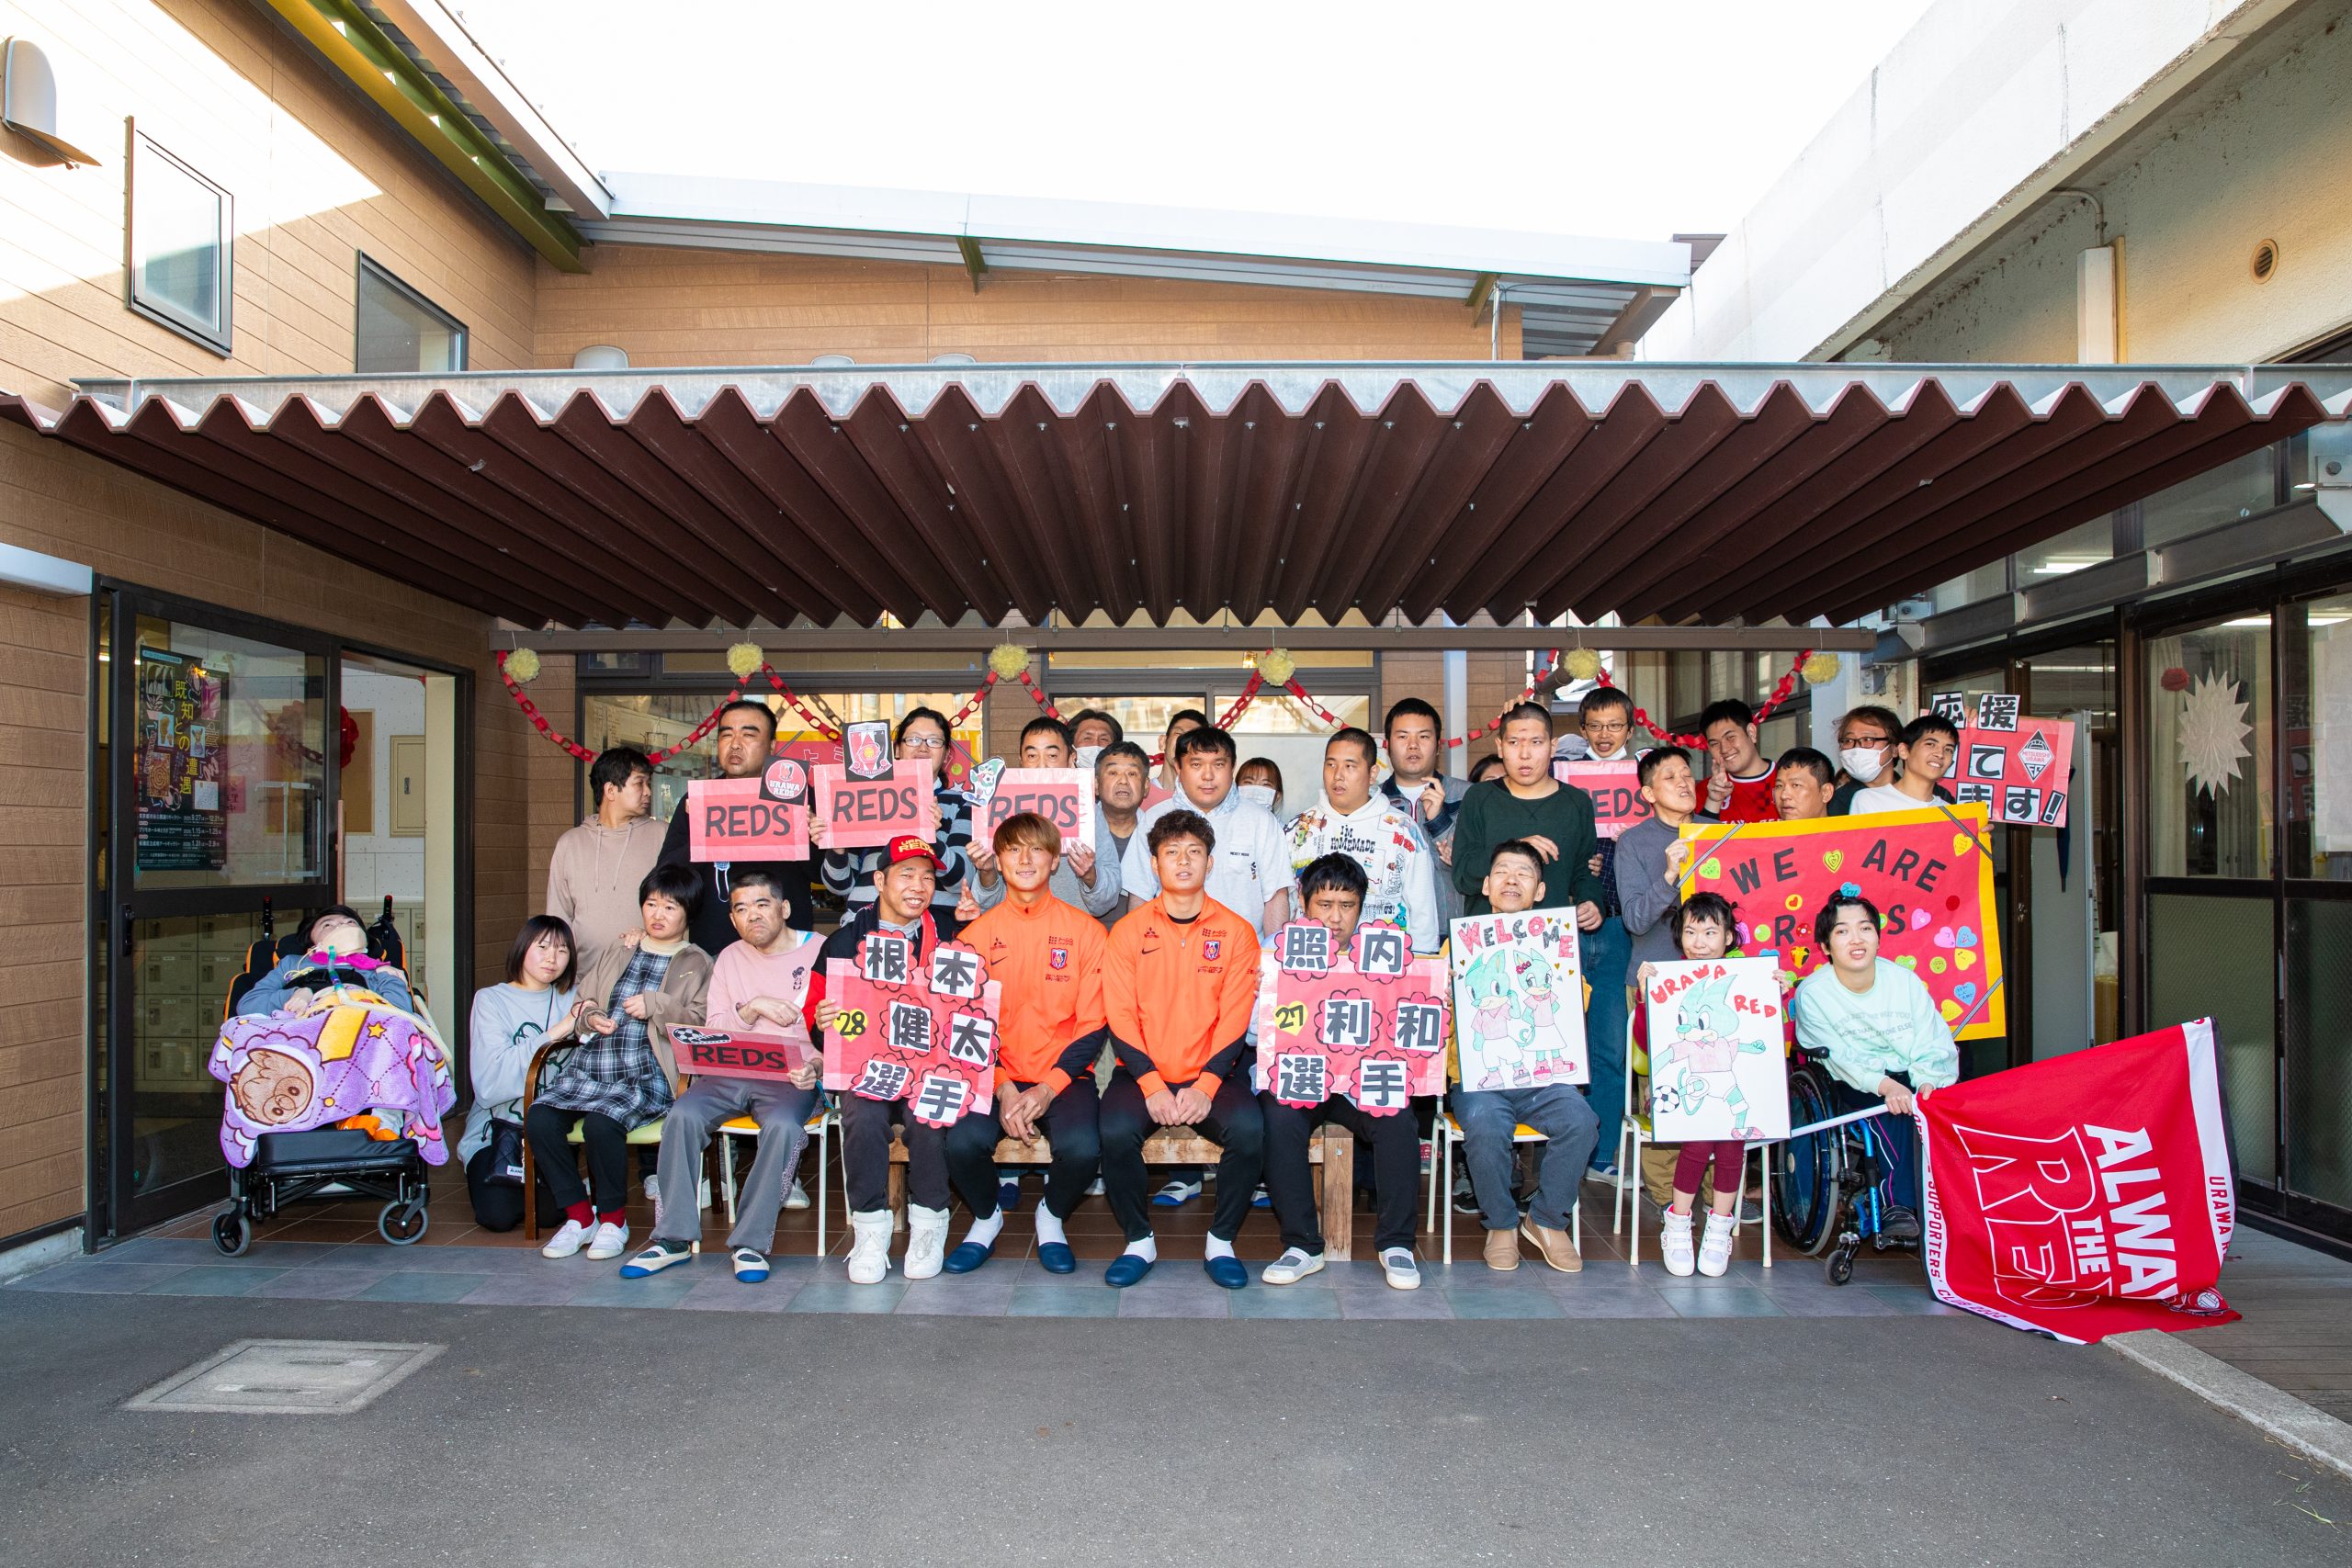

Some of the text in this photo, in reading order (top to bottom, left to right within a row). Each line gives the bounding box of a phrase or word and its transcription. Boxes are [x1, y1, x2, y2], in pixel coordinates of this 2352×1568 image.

[175, 680, 198, 794] 既知との遭遇
[769, 780, 800, 792] URAWA
[773, 788, 795, 797] REDS
[832, 787, 918, 822] REDS
[1580, 787, 1651, 818] EDS
[706, 805, 791, 837] REDS
[1330, 837, 1376, 853] HOMEMADE
[1729, 839, 1947, 896] WE ARE
[1285, 927, 1402, 973] 照内
[1457, 916, 1574, 958] WELCOME
[866, 936, 978, 995] 根本
[1650, 964, 1726, 1004] URAWA
[840, 1010, 866, 1036] 28
[1275, 1006, 1304, 1029] 27
[1327, 1001, 1441, 1050] 利和
[1734, 995, 1777, 1018] RED
[893, 1004, 991, 1067] 健太
[692, 1043, 786, 1070] REDS
[854, 1060, 962, 1120] 選手
[1279, 1057, 1405, 1107] 選手
[2209, 1177, 2231, 1235] URAWA
[2071, 1215, 2111, 1275] THE
